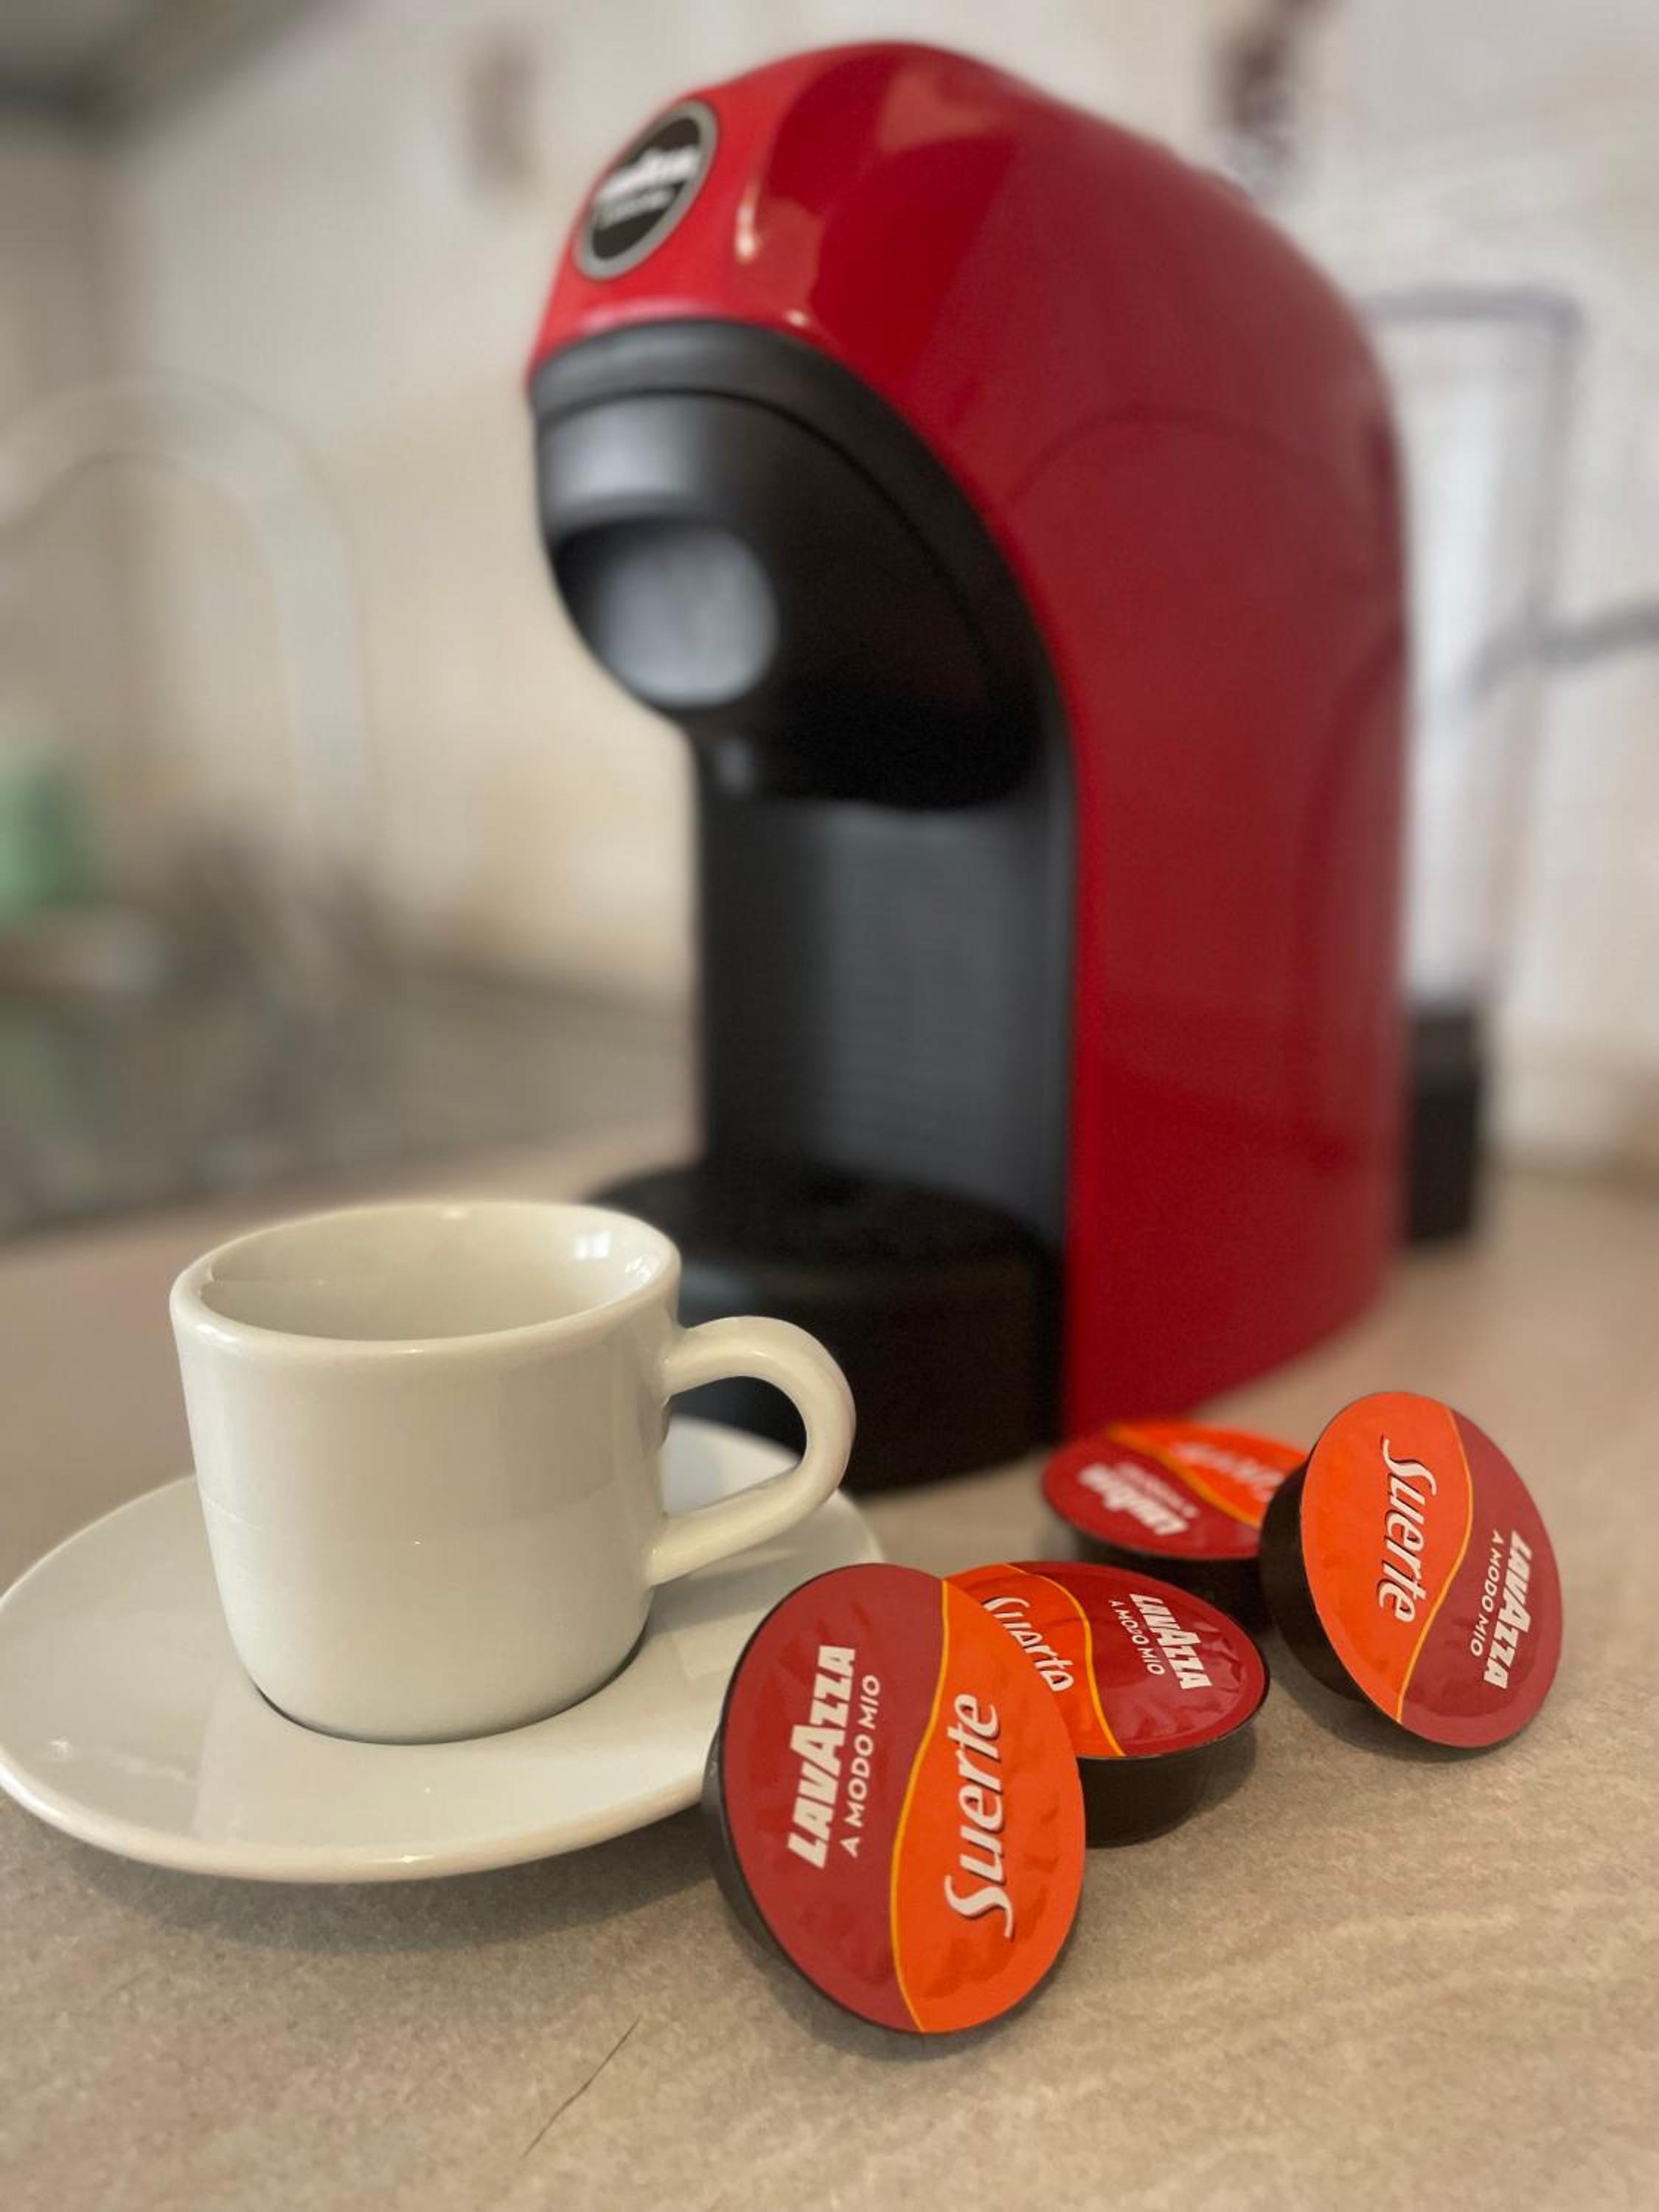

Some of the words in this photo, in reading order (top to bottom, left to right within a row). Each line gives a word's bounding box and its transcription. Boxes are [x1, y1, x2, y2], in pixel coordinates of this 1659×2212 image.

[1378, 1438, 1437, 1624] Suerte
[1492, 1529, 1505, 1546] A
[1110, 1600, 1124, 1609] A
[1482, 1548, 1501, 1613] MODO
[1483, 1529, 1532, 1689] LAVAZZA
[1115, 1608, 1150, 1645] MODO
[1130, 1593, 1213, 1690] LAVAZZA
[1470, 1613, 1489, 1658] MIO
[1138, 1644, 1166, 1676] MIO
[857, 1674, 881, 1731] MIO
[787, 1644, 856, 1869] LAVAZZA
[846, 1735, 874, 1829] MODO
[943, 1694, 1015, 1938] Suerte
[841, 1837, 861, 1858] A
